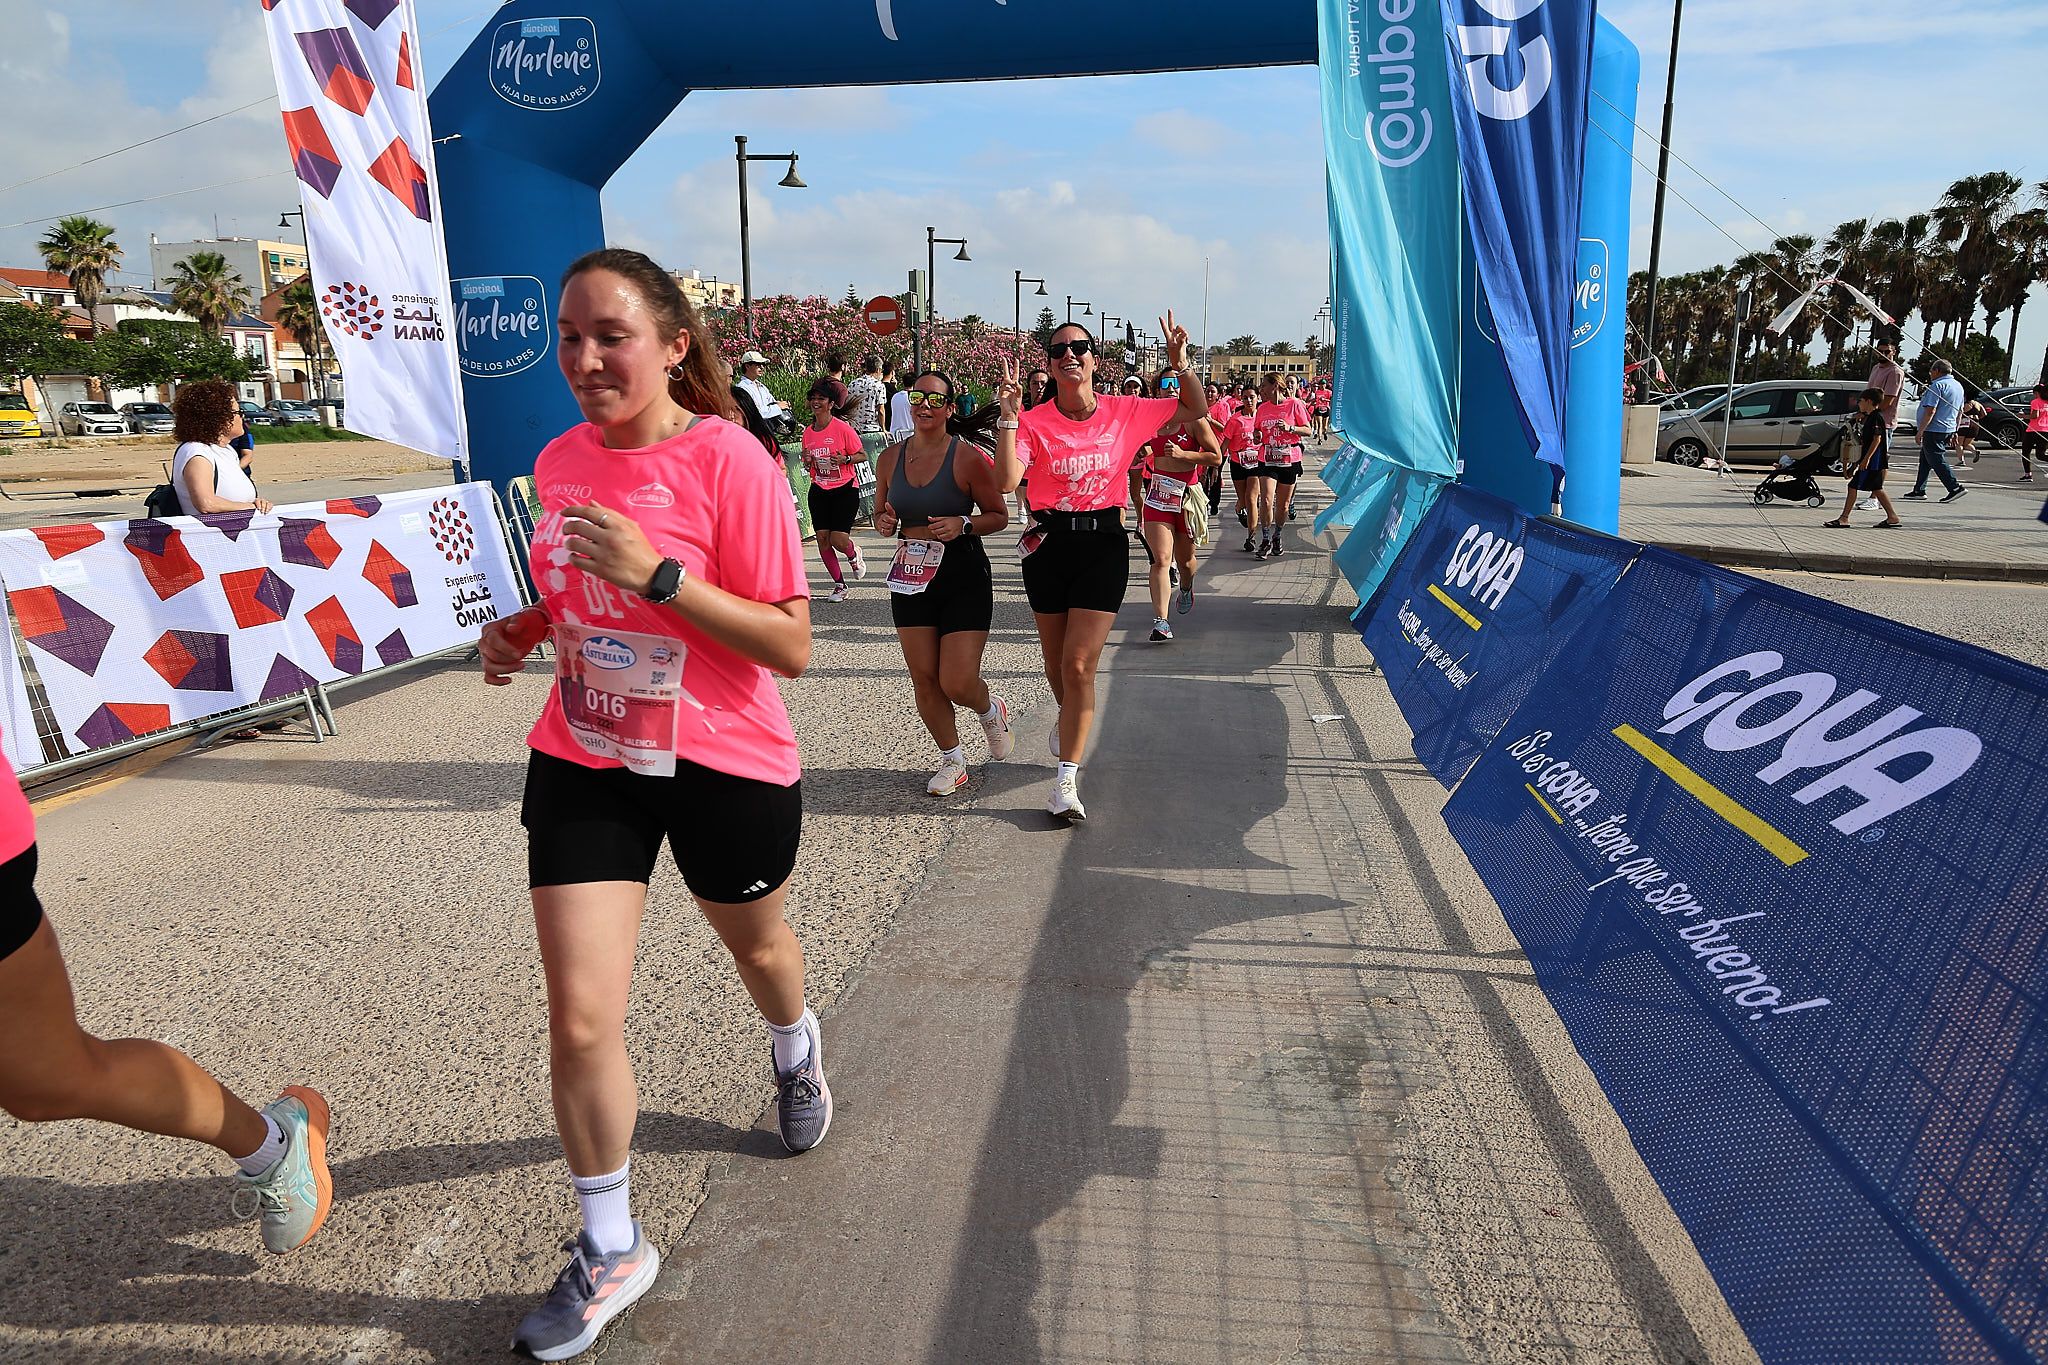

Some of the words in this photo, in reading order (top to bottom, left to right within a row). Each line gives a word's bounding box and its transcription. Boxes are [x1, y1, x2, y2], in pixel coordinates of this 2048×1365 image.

[496, 38, 592, 85] Marlene
[501, 83, 520, 100] HIJA
[523, 94, 536, 104] DE
[538, 96, 558, 105] LOS
[560, 85, 587, 103] ALPES
[453, 299, 540, 352] Marlene
[1572, 321, 1592, 340] PES
[471, 361, 482, 371] DE
[484, 362, 503, 372] LOS
[506, 348, 535, 368] ALPES
[1052, 453, 1110, 475] CARRERA
[445, 572, 487, 588] Experience
[1443, 524, 1525, 611] GOYA
[456, 604, 498, 628] OMAN
[584, 646, 631, 665] ASTURIANA
[586, 688, 627, 718] 016
[624, 737, 658, 749] VALENCIA
[1656, 650, 1983, 836] GOYA
[1522, 756, 1552, 773] es
[1536, 761, 1599, 817] GOYA
[1588, 857, 1668, 891] que
[1646, 882, 1703, 917] ser
[1678, 911, 1832, 1021] bueno!
